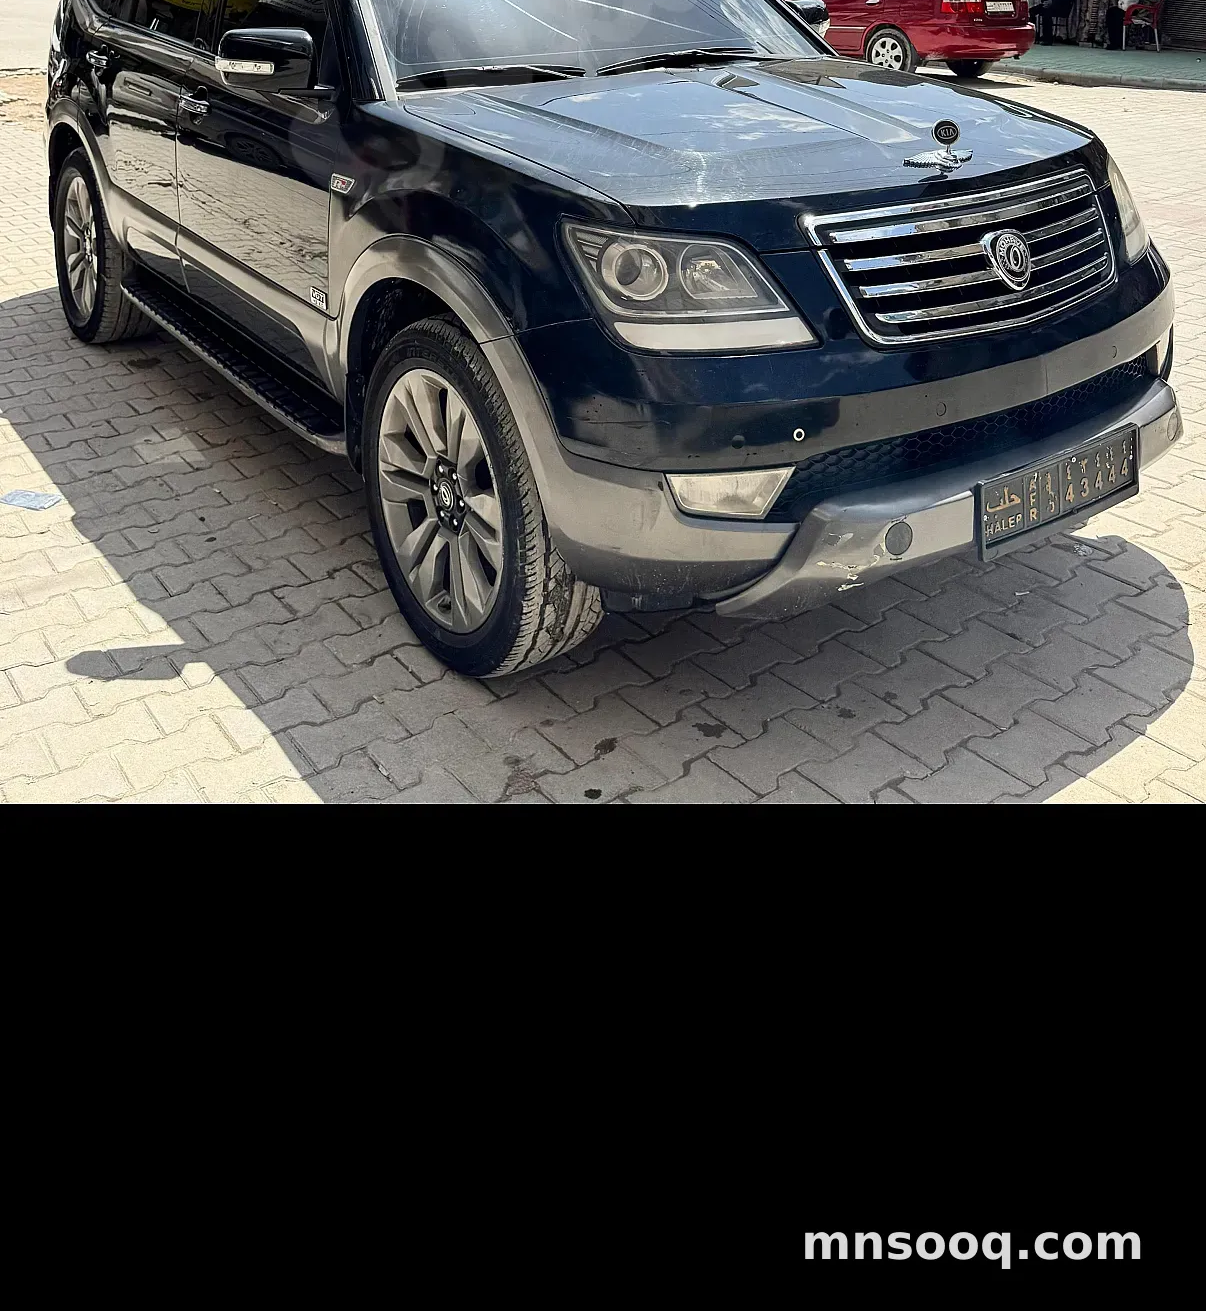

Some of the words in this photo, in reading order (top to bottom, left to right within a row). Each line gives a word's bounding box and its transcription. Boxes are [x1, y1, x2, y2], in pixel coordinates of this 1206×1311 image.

[940, 128, 955, 137] KIA
[1065, 457, 1129, 503] 43444
[986, 485, 1022, 516] حلب
